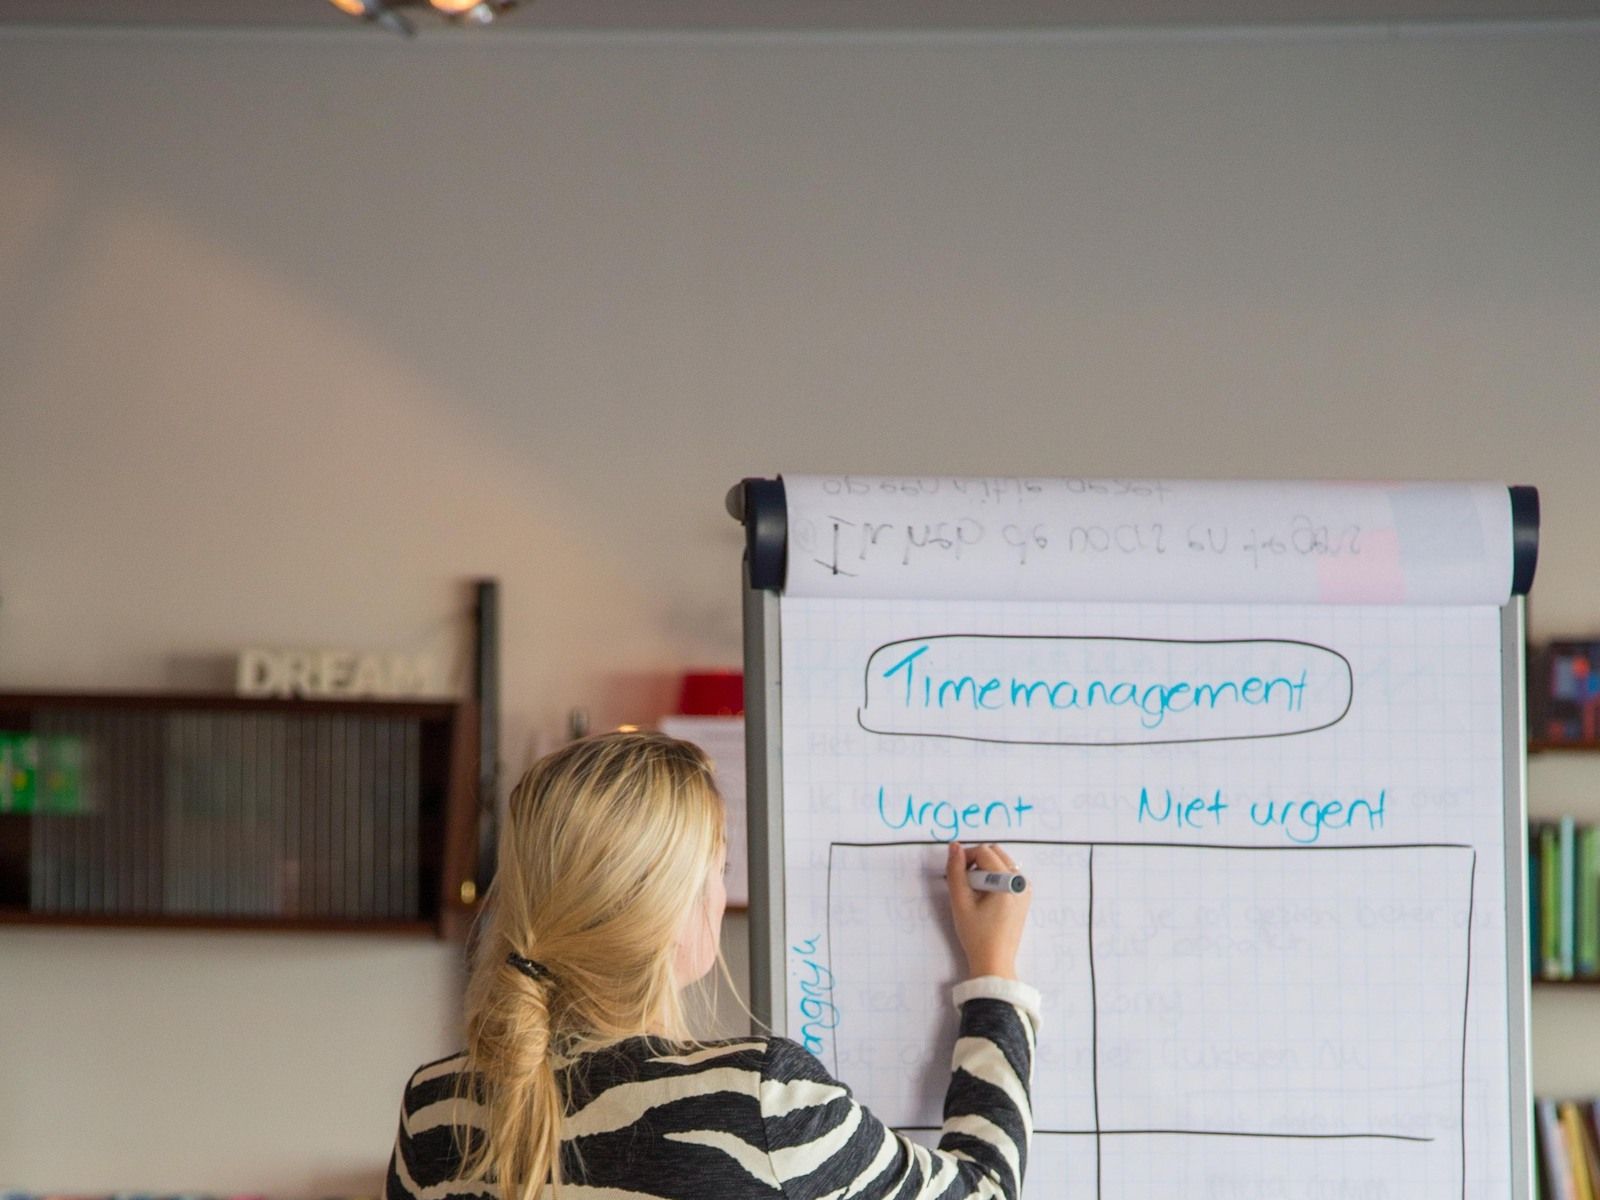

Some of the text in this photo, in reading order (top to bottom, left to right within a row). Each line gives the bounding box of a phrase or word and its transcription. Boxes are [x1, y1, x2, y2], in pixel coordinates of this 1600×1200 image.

[234, 650, 453, 699] DREAM
[882, 645, 1308, 728] Timemanagement
[876, 786, 1035, 840] Urgent
[1137, 787, 1228, 827] Niet
[1249, 789, 1387, 844] urgent
